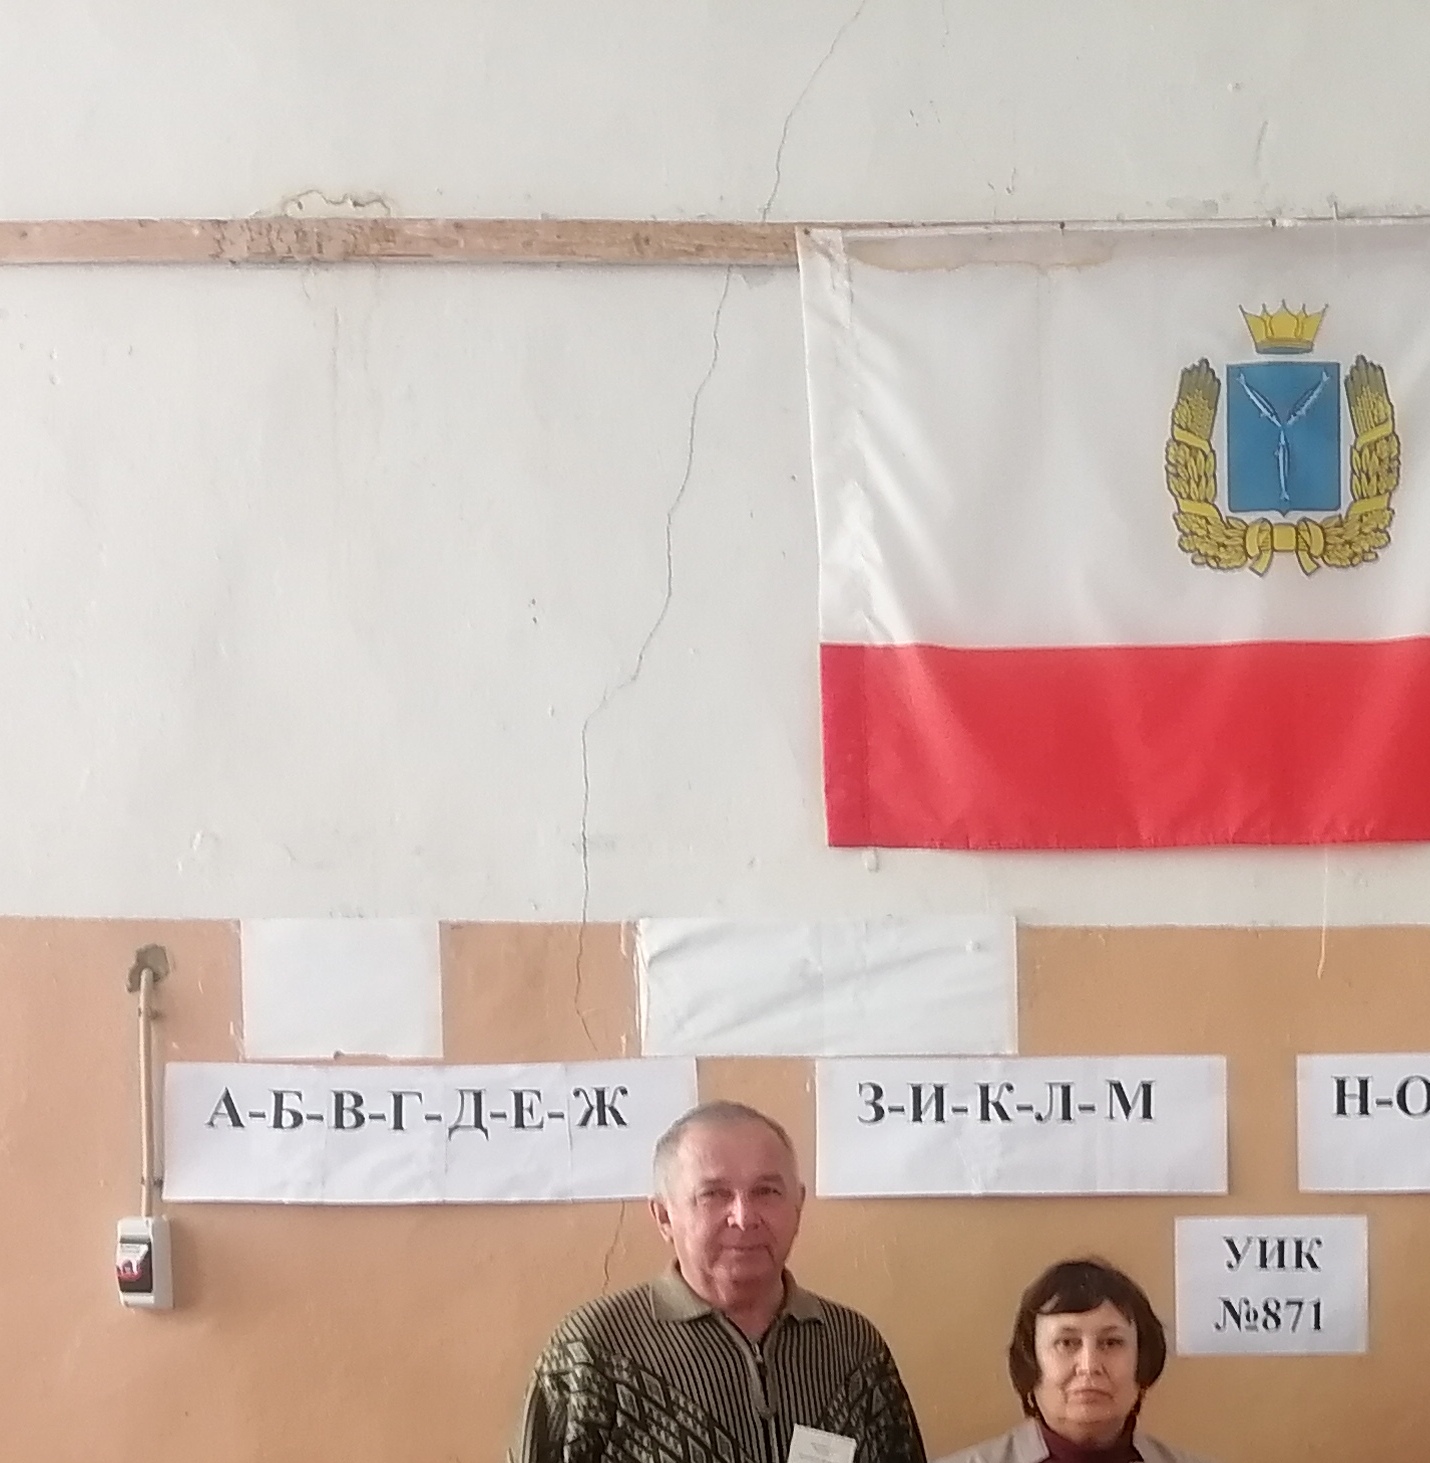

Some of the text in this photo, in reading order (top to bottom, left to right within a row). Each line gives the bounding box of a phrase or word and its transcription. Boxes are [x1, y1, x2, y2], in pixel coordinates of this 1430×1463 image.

[206, 1085, 630, 1140] А-Б-В-Г-Д-Е-Ж
[857, 1080, 1154, 1124] З-И-К-Л-М
[1223, 1236, 1323, 1272] УИК
[1213, 1298, 1323, 1333] №871
